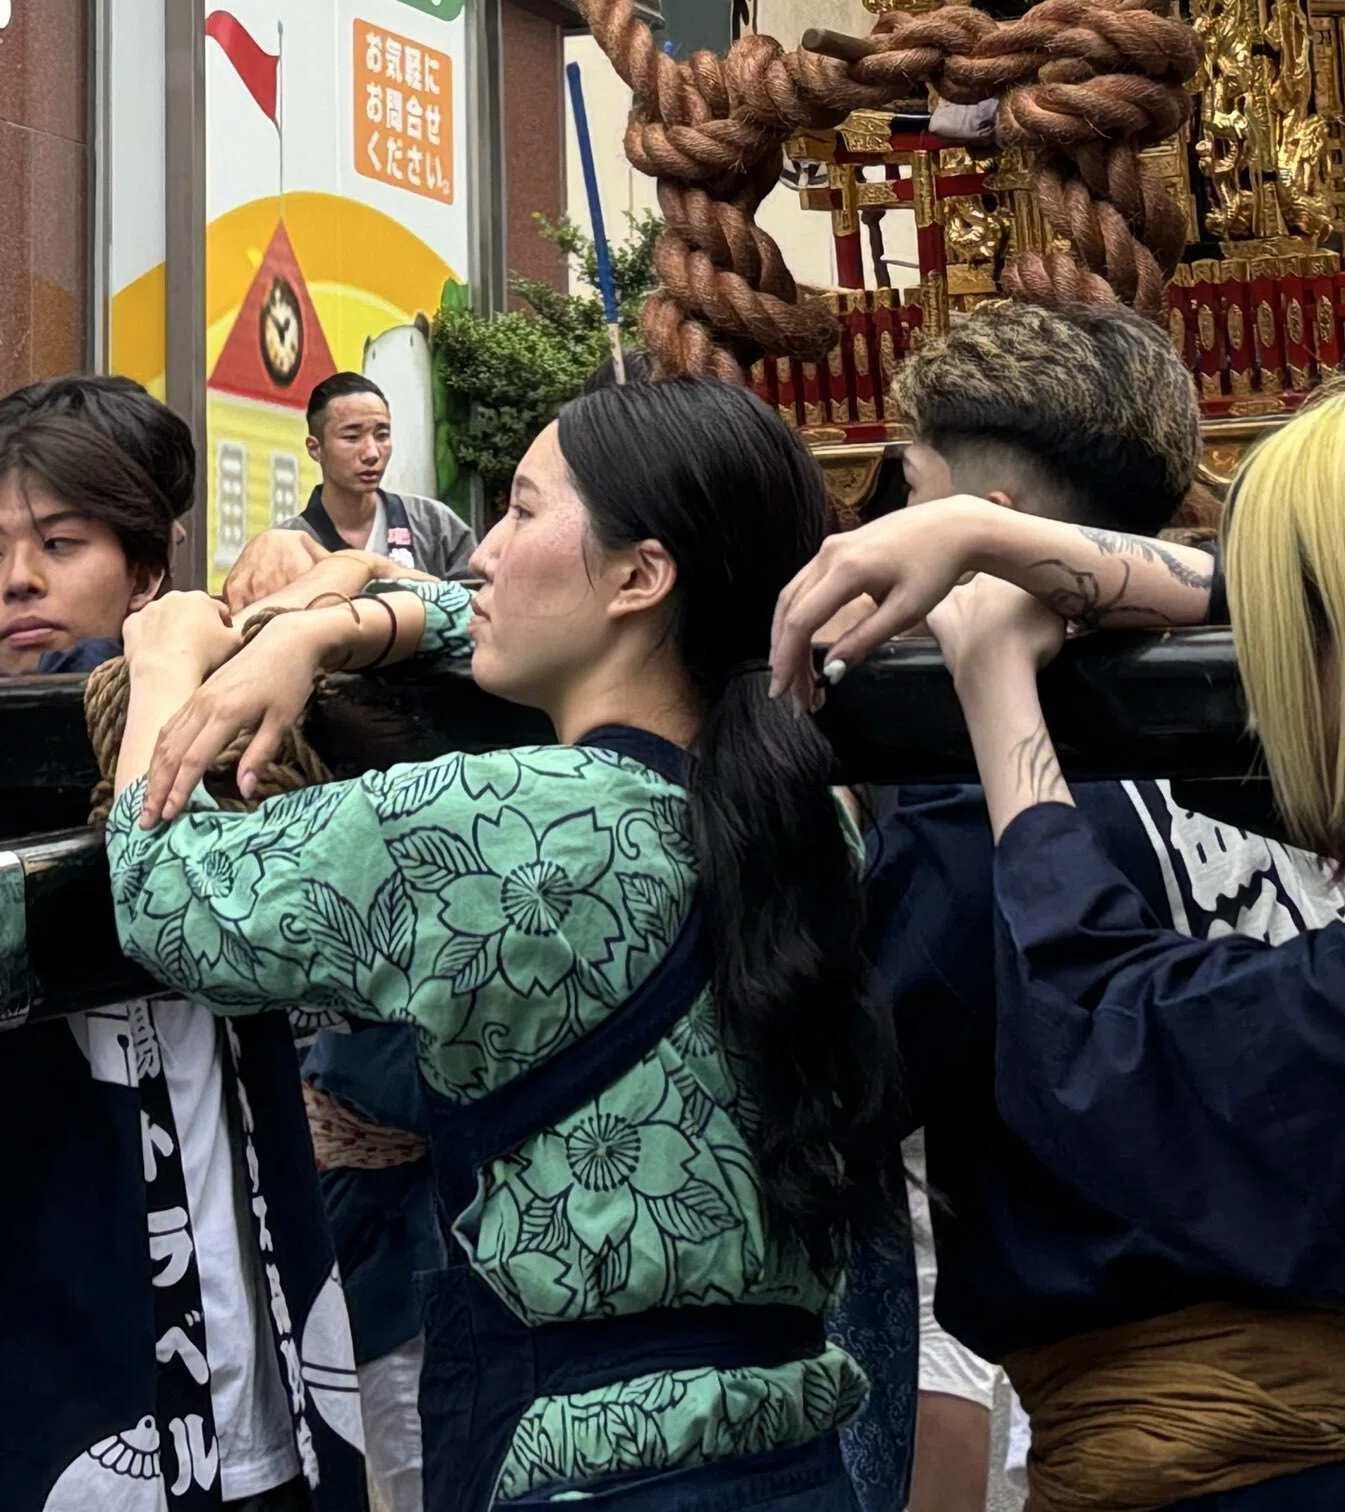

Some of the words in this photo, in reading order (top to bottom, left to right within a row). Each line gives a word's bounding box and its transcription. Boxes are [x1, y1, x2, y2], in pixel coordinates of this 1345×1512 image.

[366, 31, 441, 95] お気軽に
[366, 81, 441, 145] お問合せ
[367, 131, 450, 195] ください。
